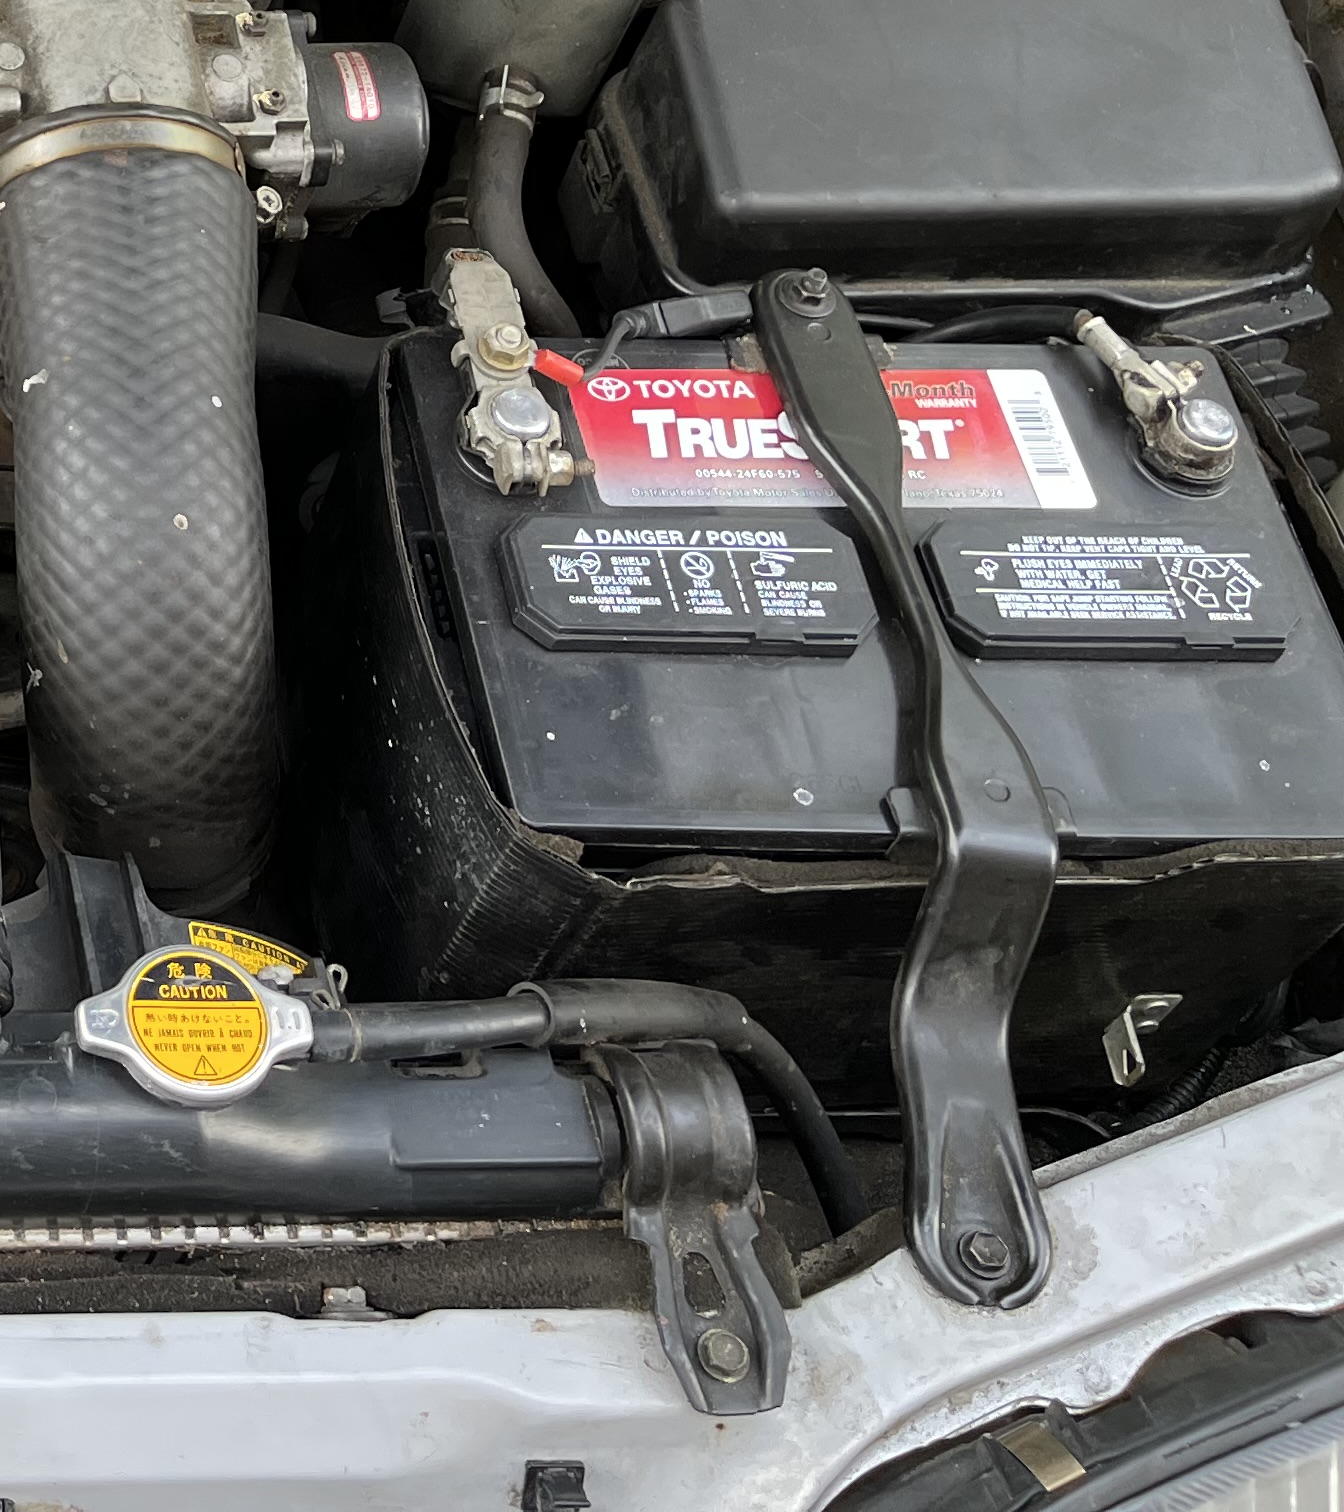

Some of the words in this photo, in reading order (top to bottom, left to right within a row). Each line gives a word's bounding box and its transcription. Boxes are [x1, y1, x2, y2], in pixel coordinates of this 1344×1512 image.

[633, 379, 755, 399] TOYOTA
[914, 398, 977, 409] WARRANTY
[631, 487, 693, 497] Distributed
[696, 487, 710, 498] by
[712, 488, 750, 498] Toyota
[753, 488, 788, 497] Motor
[791, 488, 821, 497] Sales
[969, 489, 1003, 498] 75024
[596, 529, 685, 545] DANGER
[689, 530, 701, 545] /
[707, 530, 787, 547] POISON
[1045, 536, 1063, 544] OUT
[1078, 536, 1096, 544] THE
[1140, 537, 1184, 545] CHILDREN
[610, 556, 651, 566] SHIELD
[1011, 558, 1046, 569] FLUSH
[1046, 559, 1074, 569] EYES
[1074, 559, 1143, 569] IMMEDIATELY
[614, 566, 643, 576] EYES
[1015, 569, 1044, 579] WITH
[1086, 570, 1107, 580] GET
[590, 576, 652, 586] EXPLOSIVE
[693, 579, 710, 589] NO
[754, 580, 809, 591] SULFURIC
[811, 581, 838, 591] ACID
[1019, 579, 1066, 589] MEDICAL
[1066, 579, 1093, 589] HELP
[1094, 580, 1120, 589] FAST
[593, 586, 632, 595] GASES
[687, 589, 722, 598] SPARKS
[757, 590, 776, 599] CAN
[691, 598, 724, 607] FLAMES
[1207, 612, 1253, 621] RECYCLE
[159, 985, 228, 999] CAUTION
[143, 1028, 153, 1037] NE
[154, 1043, 177, 1052] NEVER
[182, 1043, 201, 1052] OPEN
[206, 1043, 227, 1052] WHEN
[231, 1043, 245, 1052] HOT
